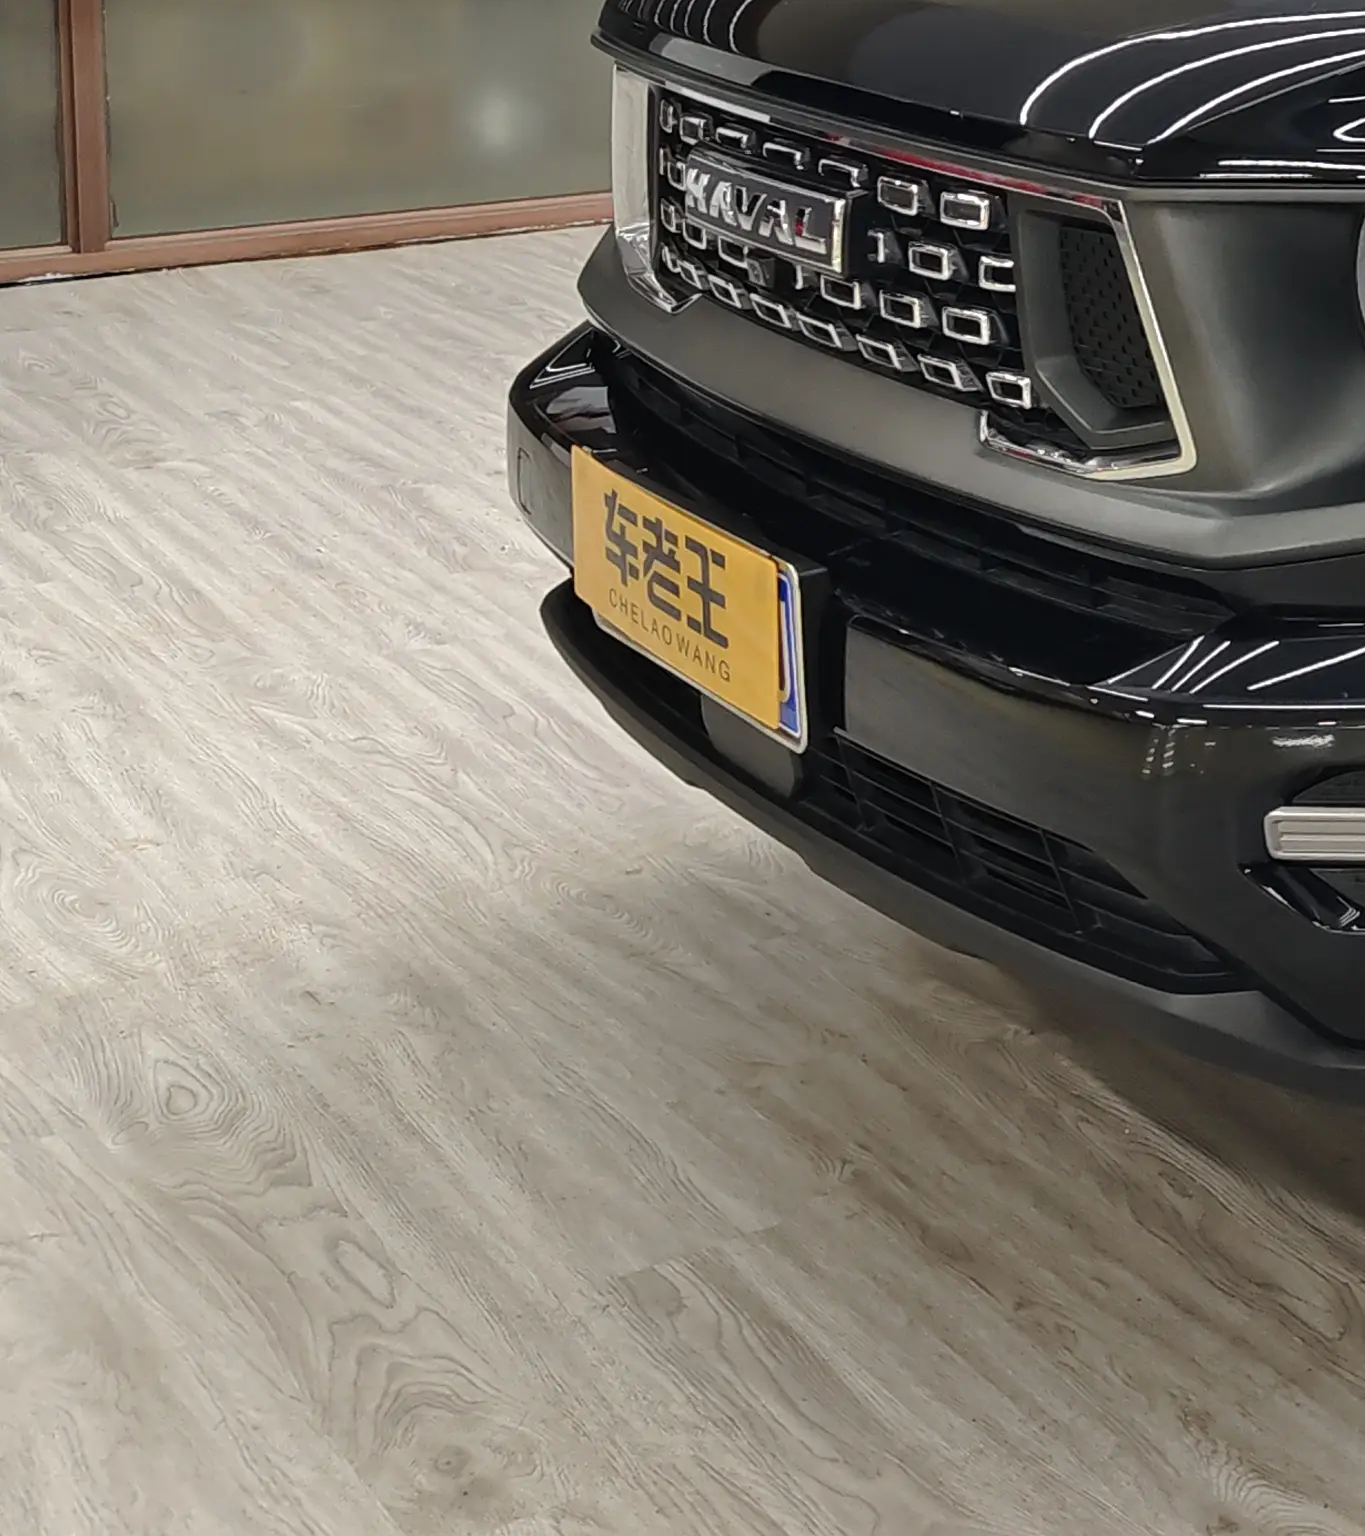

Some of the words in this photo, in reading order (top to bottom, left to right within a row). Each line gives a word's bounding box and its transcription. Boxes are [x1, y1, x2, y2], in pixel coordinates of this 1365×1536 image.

[686, 167, 828, 255] HAVAL
[603, 488, 730, 650] 车老王
